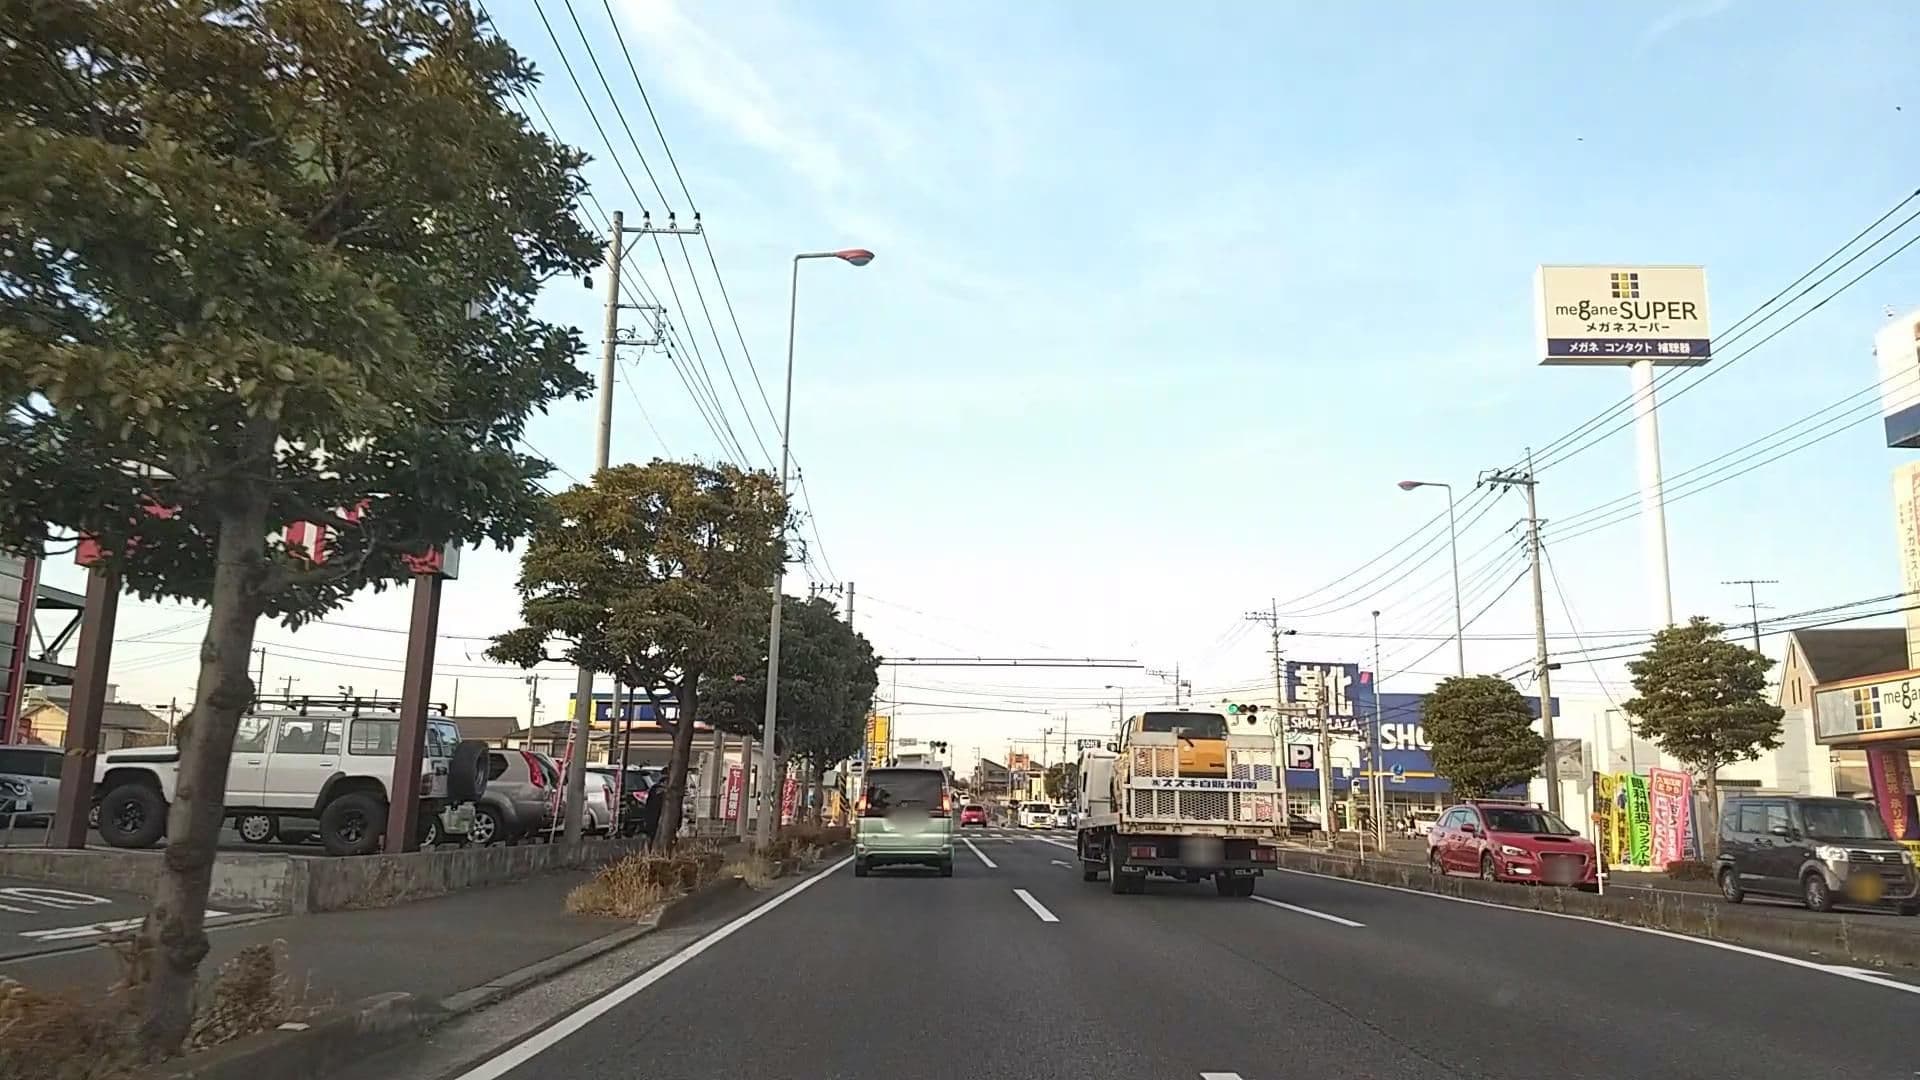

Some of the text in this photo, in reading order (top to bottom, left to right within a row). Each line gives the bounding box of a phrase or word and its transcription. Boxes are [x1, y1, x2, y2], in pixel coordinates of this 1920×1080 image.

[1586, 322, 1671, 333] メガネスーパー
[1569, 342, 1600, 352] メガネ
[1605, 342, 1654, 353] コンタクト
[1294, 665, 1354, 716] 靴
[1289, 745, 1312, 768] P
